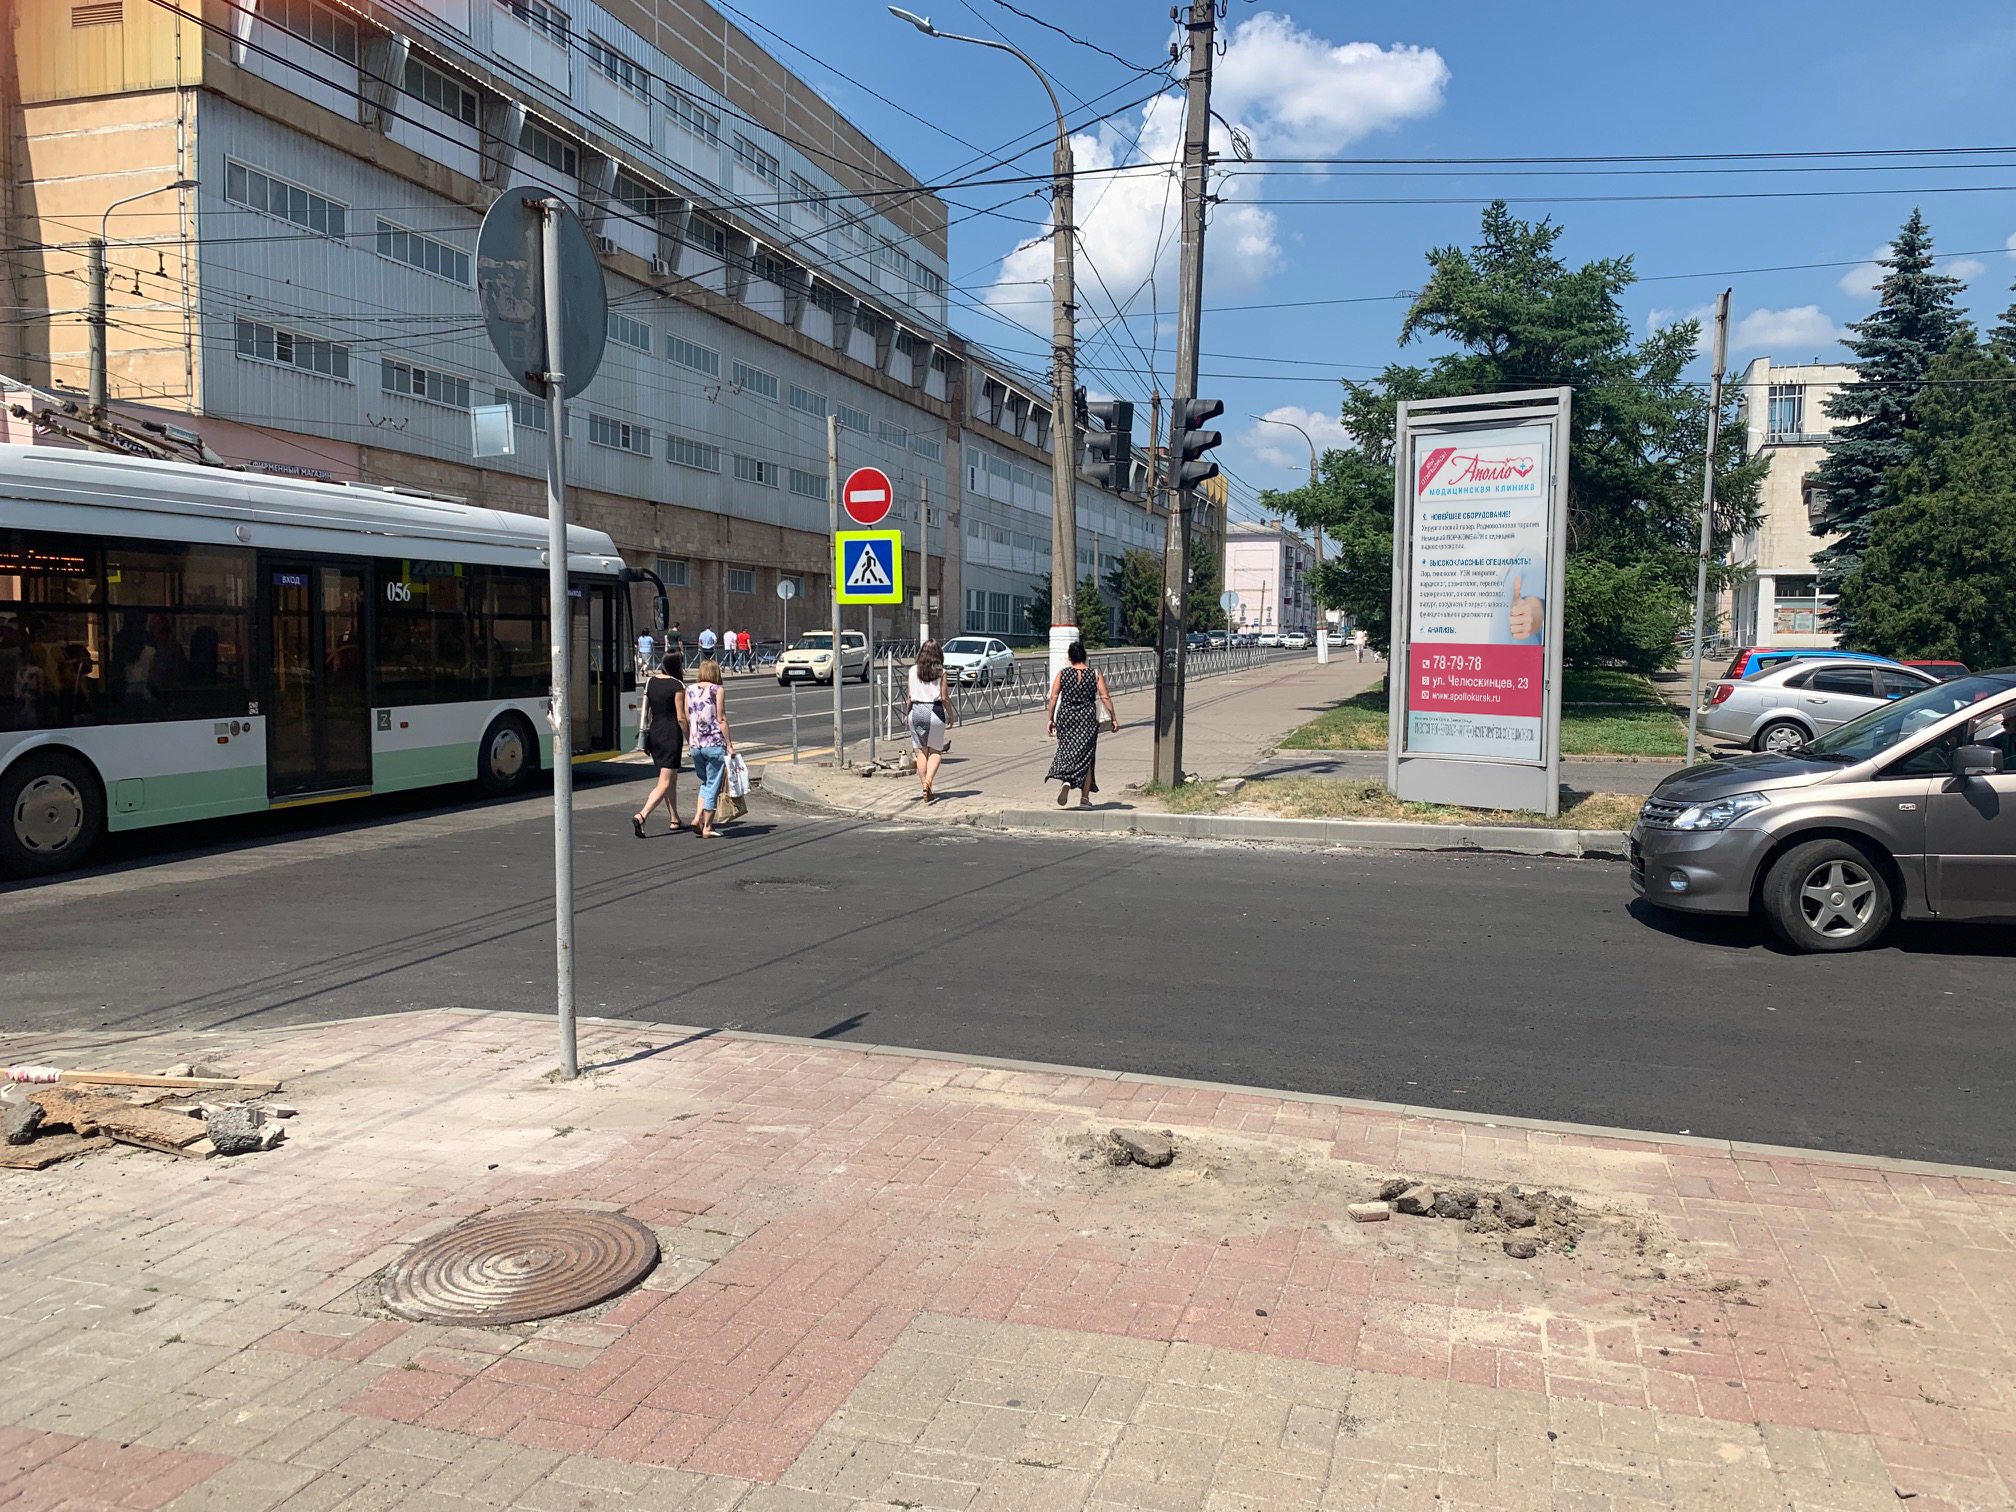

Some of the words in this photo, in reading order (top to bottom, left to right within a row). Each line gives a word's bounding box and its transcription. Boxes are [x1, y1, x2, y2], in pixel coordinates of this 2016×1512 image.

[300, 468, 332, 480] МАГАЗИН
[282, 575, 301, 586] ВХОД
[386, 581, 411, 602] 056
[1433, 655, 1482, 671] 78-79-78
[1432, 676, 1446, 688] ул.
[1448, 675, 1515, 691] Челюскинцев,
[1517, 677, 1529, 690] 23
[1432, 692, 1501, 703] www.apollokursk.ru
